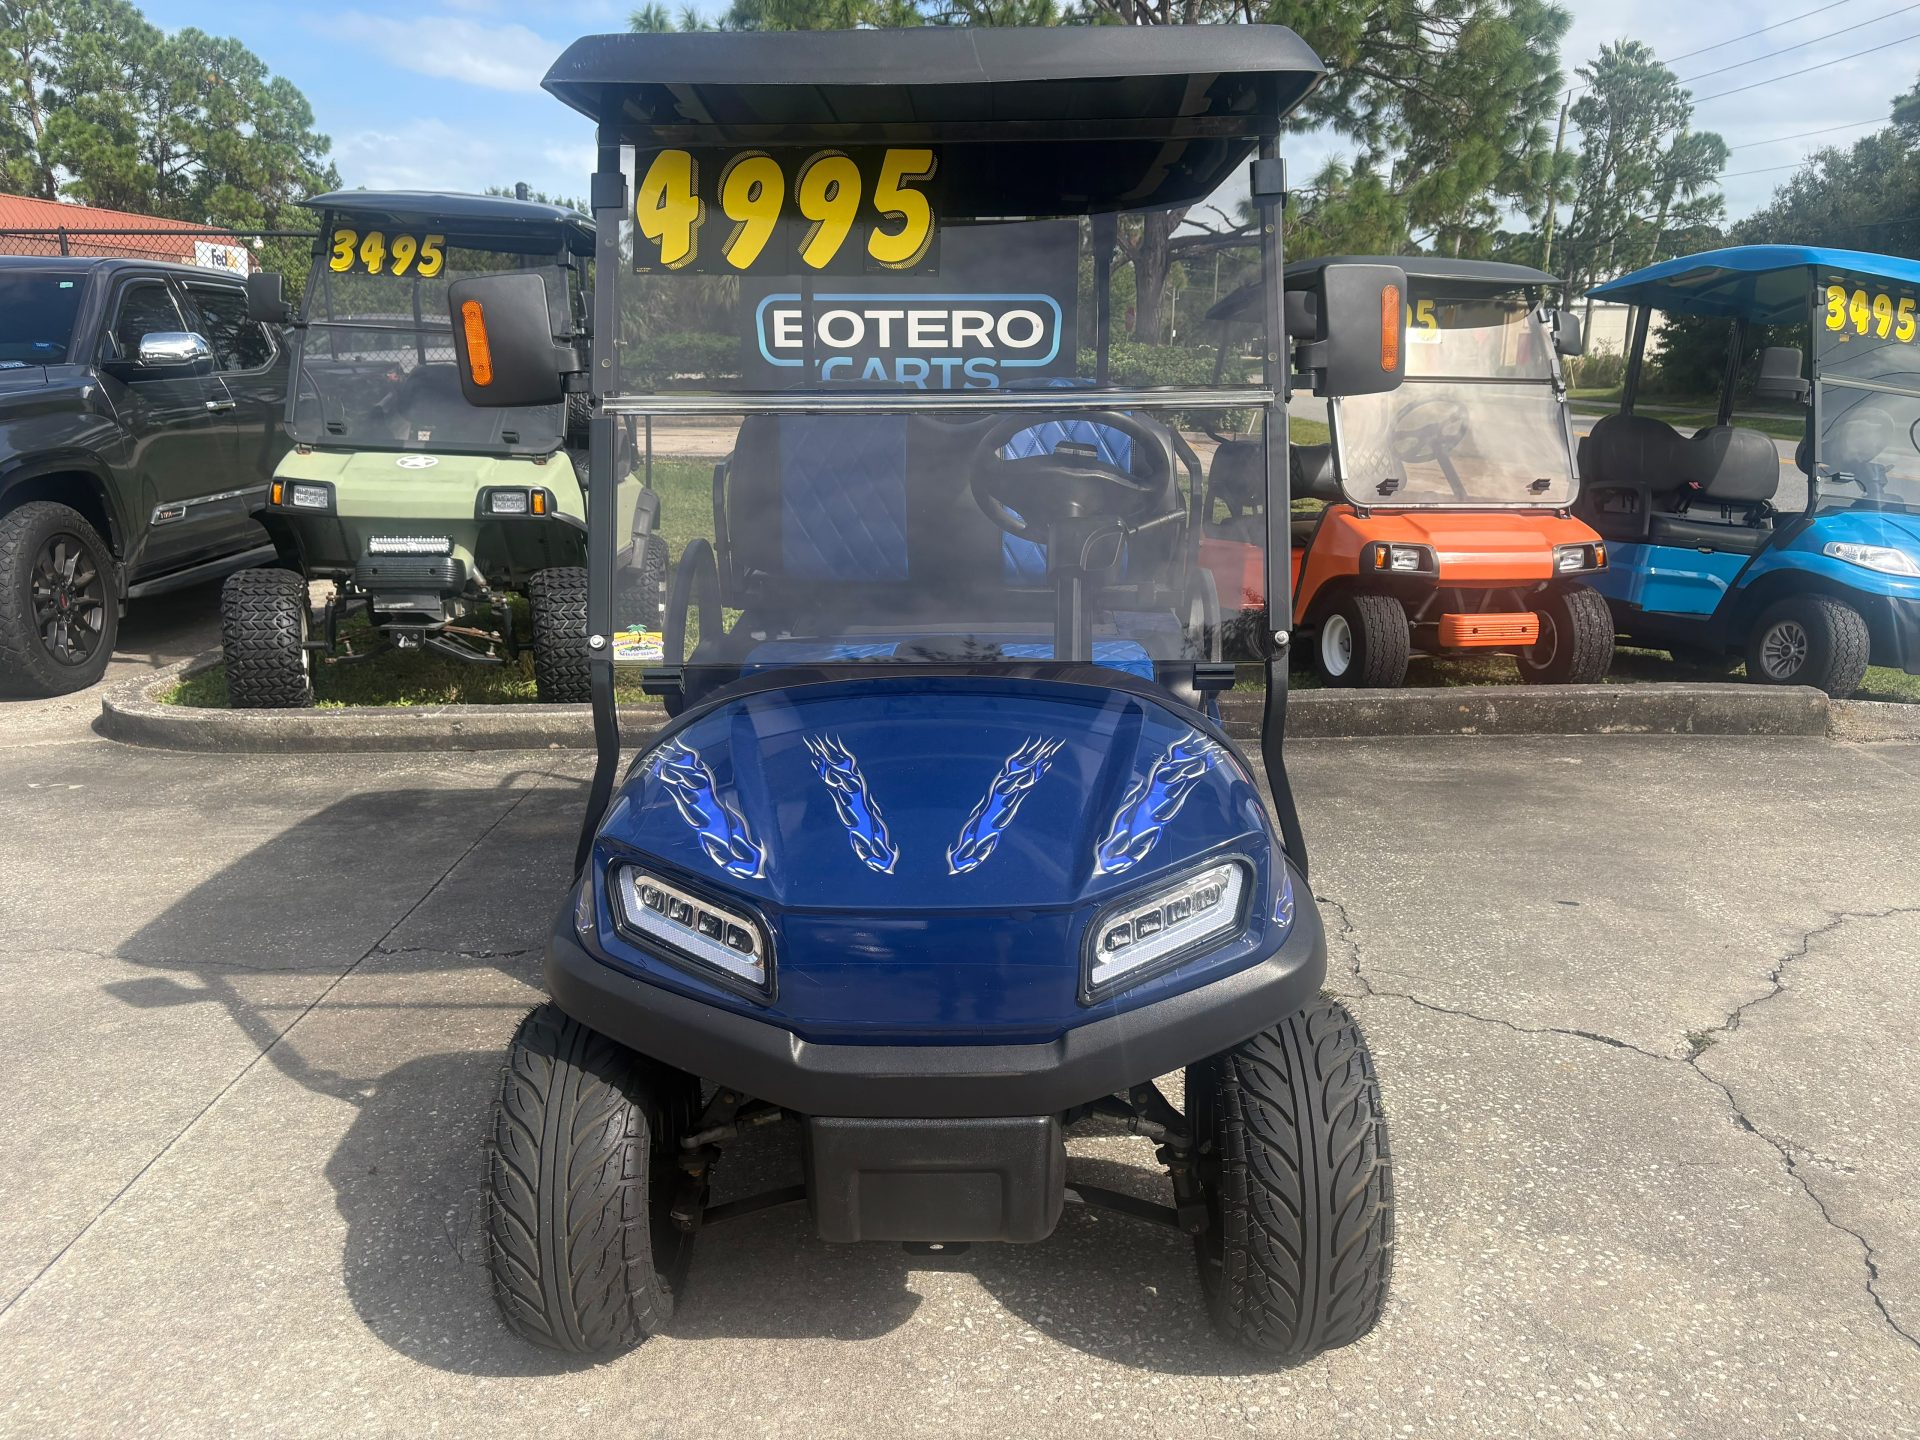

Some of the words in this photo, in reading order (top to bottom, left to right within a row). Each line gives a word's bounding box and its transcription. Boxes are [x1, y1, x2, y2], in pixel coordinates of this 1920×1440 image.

[636, 149, 938, 270] 4995
[329, 229, 446, 278] 3495
[1825, 285, 1916, 343] 3495
